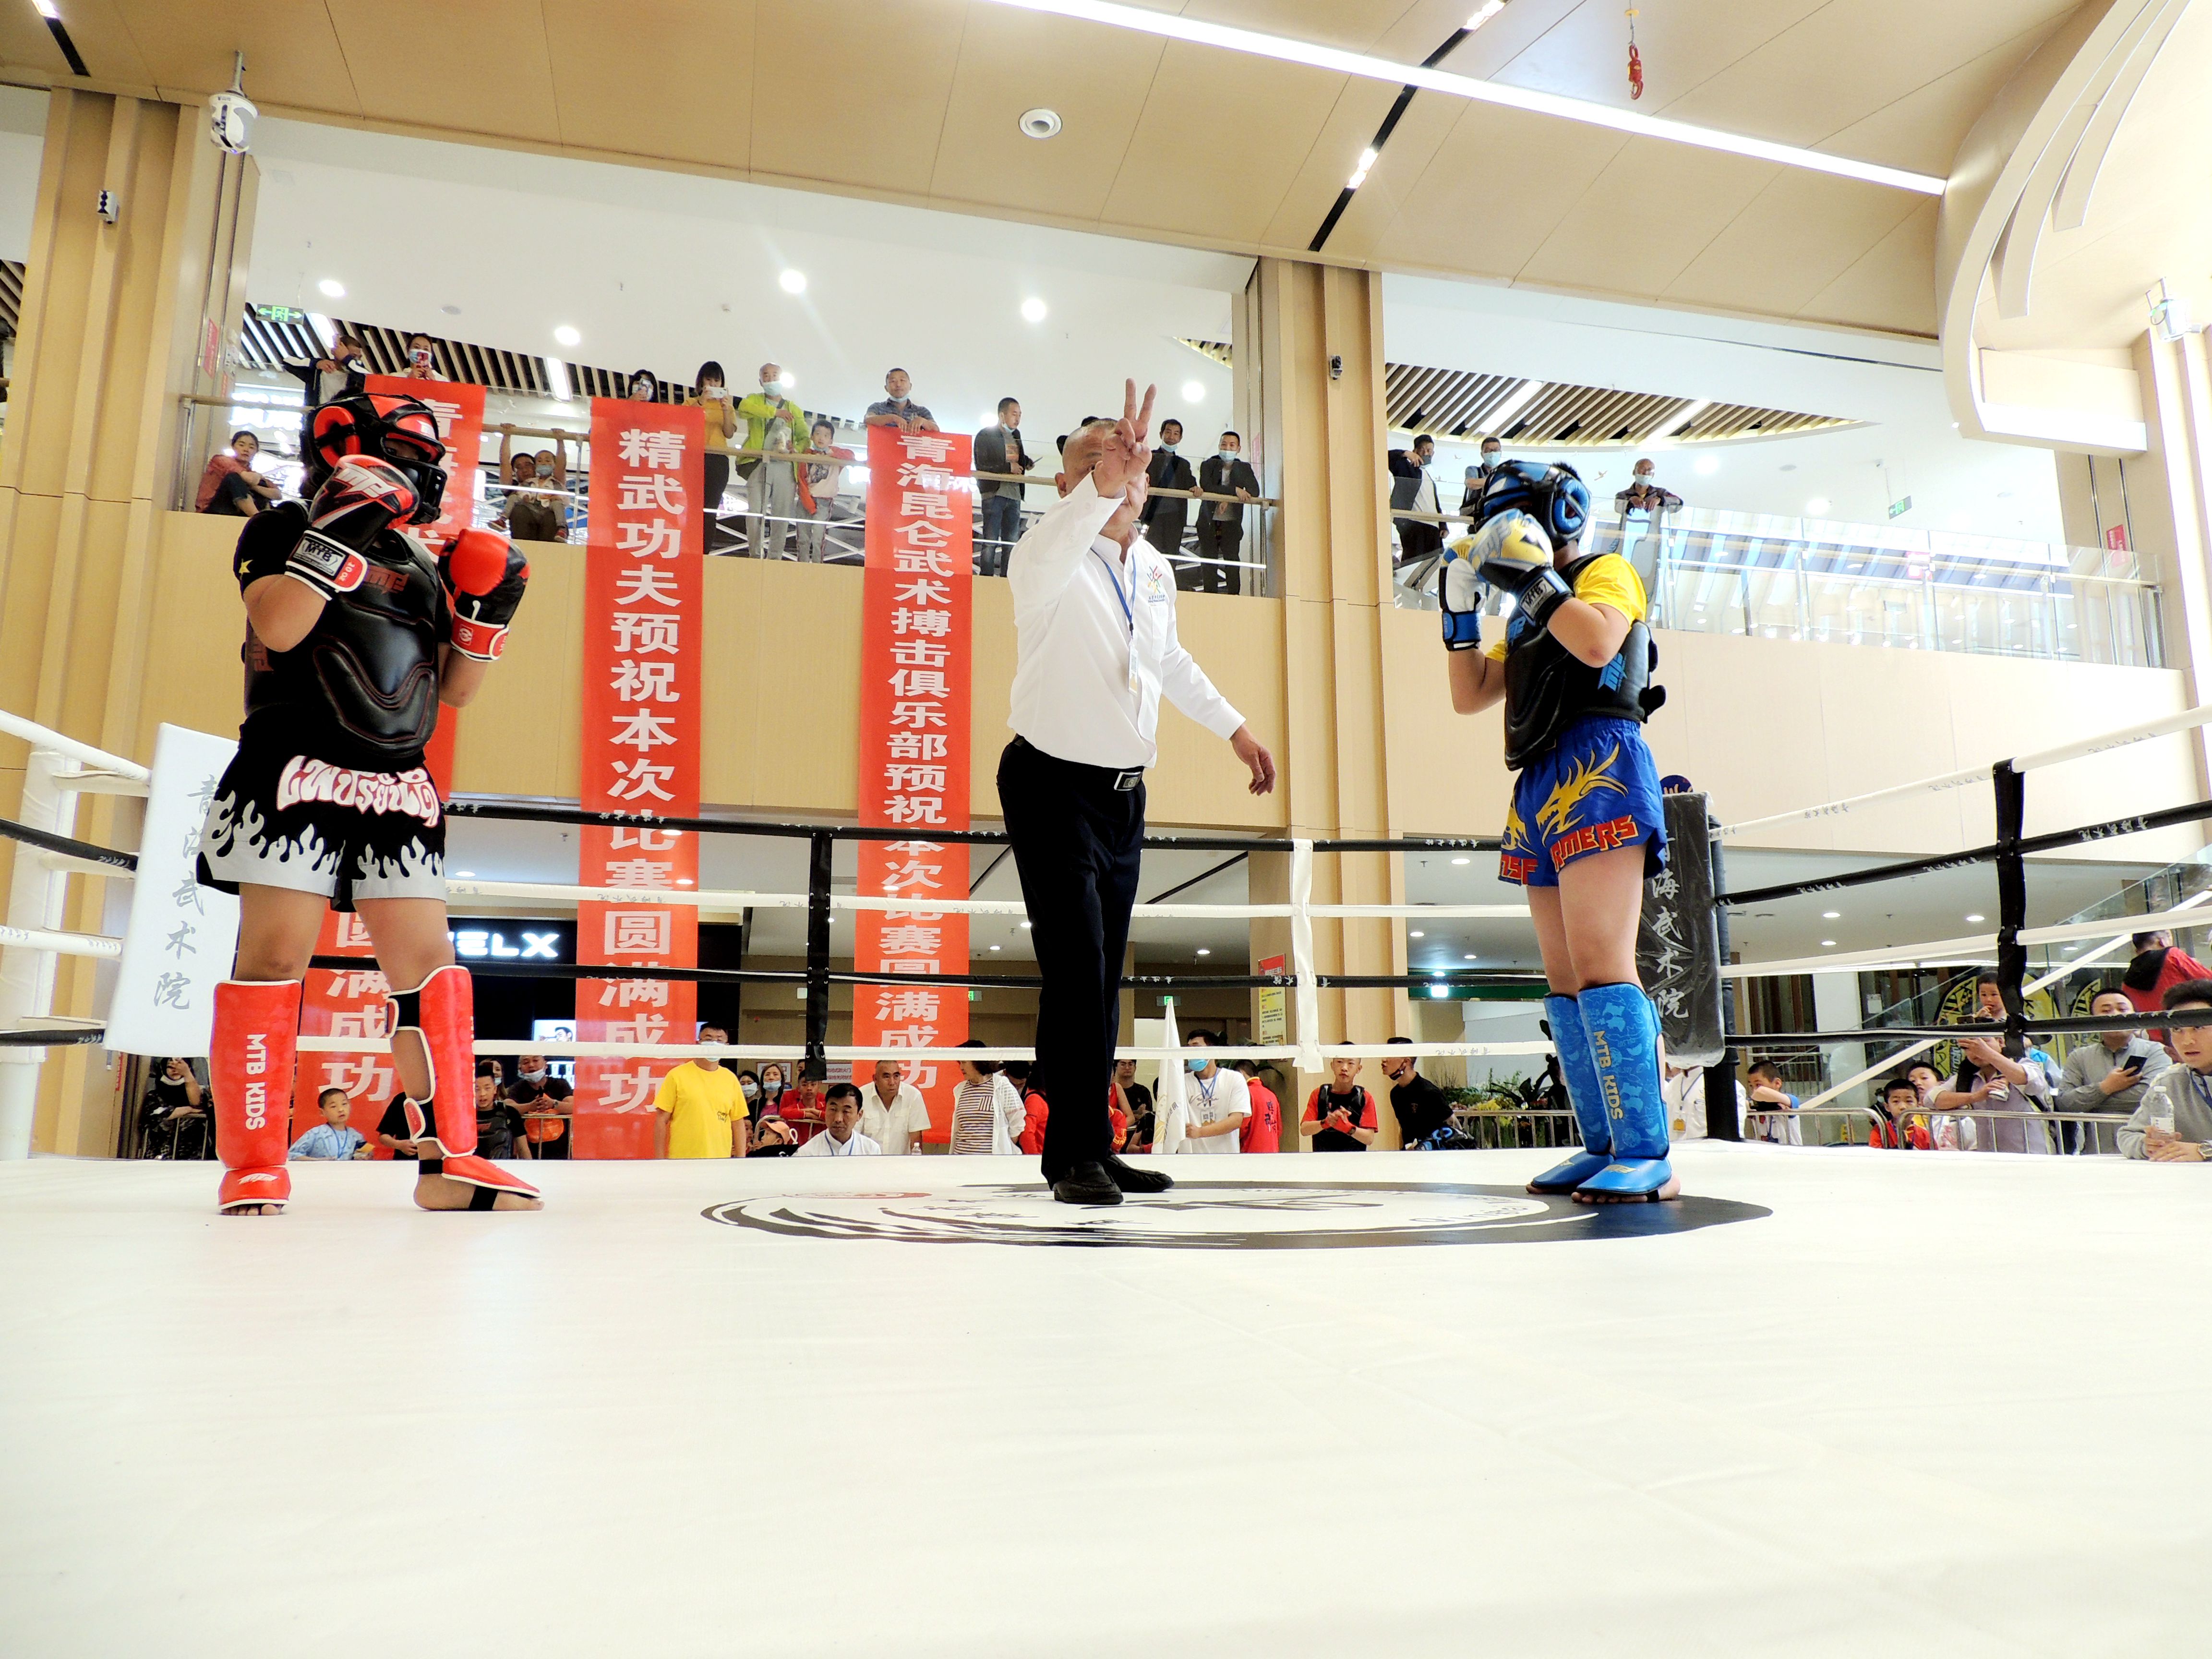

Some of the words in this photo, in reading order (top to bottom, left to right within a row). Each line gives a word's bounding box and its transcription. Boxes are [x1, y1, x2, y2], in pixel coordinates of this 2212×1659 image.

[598, 428, 685, 1114] 精武功夫预祝本次比赛圆满成功
[246, 1034, 266, 1075] MTB
[1593, 1030, 1612, 1069] MTB
[245, 1082, 265, 1131] KIDS
[1602, 1074, 1623, 1120] KIDS
